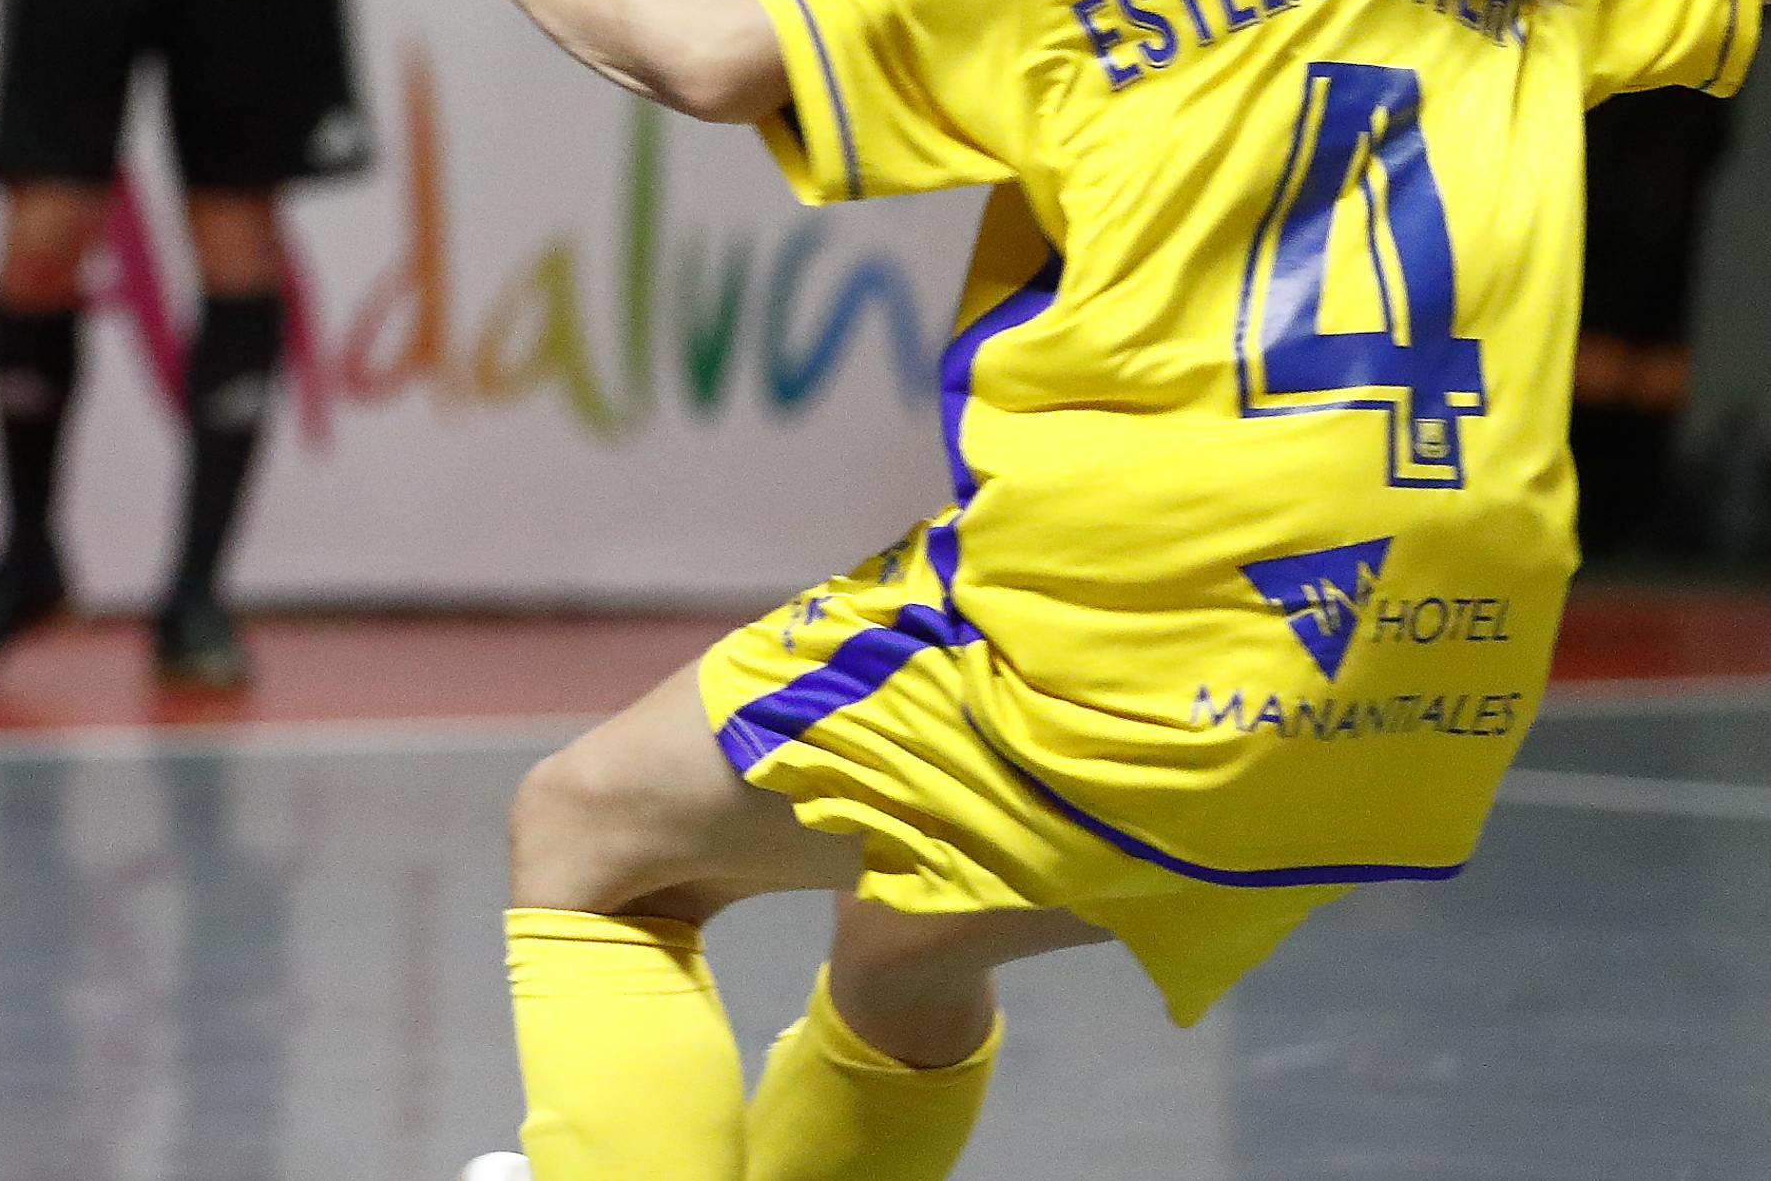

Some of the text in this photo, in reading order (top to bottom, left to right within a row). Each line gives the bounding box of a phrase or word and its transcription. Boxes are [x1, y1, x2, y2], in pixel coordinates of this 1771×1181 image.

[1235, 61, 1486, 489] 4
[1372, 596, 1512, 644] HOTEL
[1185, 683, 1522, 741] MANANTIALES
